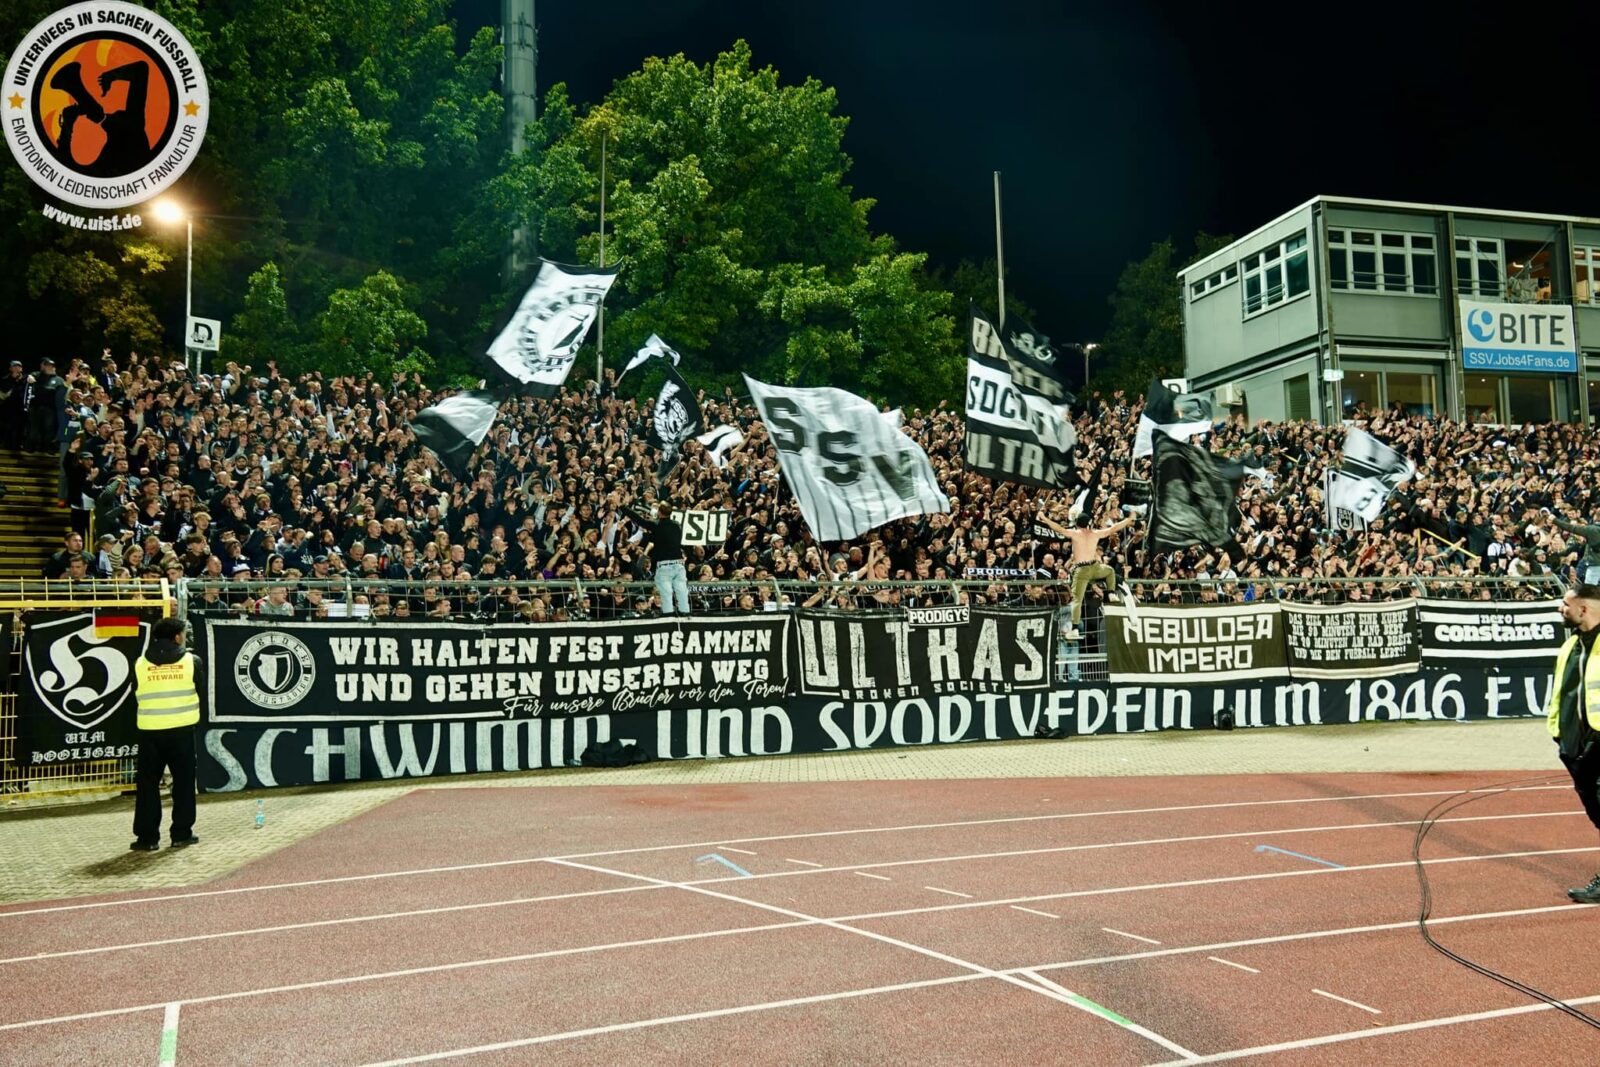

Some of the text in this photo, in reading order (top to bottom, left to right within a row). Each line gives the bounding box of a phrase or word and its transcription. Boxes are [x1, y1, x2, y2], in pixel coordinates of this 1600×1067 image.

[194, 322, 213, 344] D
[1500, 313, 1566, 346] BITE
[1469, 352, 1570, 369] SSV.Jobs4Fans.de
[1033, 524, 1055, 538] SSV
[909, 607, 970, 624] PRODIGYS
[1479, 614, 1513, 625] nero
[1122, 613, 1274, 645] NEBULOSA
[1434, 622, 1555, 642] constante
[329, 629, 772, 667] WIR HALTEN FEST ZUSAMMEN
[800, 617, 1046, 689] ULTRAS
[1147, 644, 1253, 673] IMPERO
[147, 673, 184, 681] STEWARD
[335, 658, 769, 703] UND GEHEN UNSEREN WEG
[503, 694, 543, 719] Für
[550, 698, 604, 714] unsere
[612, 686, 673, 712] Brüder
[679, 686, 706, 700] vor
[708, 683, 735, 703] den
[842, 681, 1013, 700] BROKEN SOCIETY
[657, 705, 793, 759] UND
[1345, 673, 1468, 723] 1846
[65, 731, 105, 744] ULM
